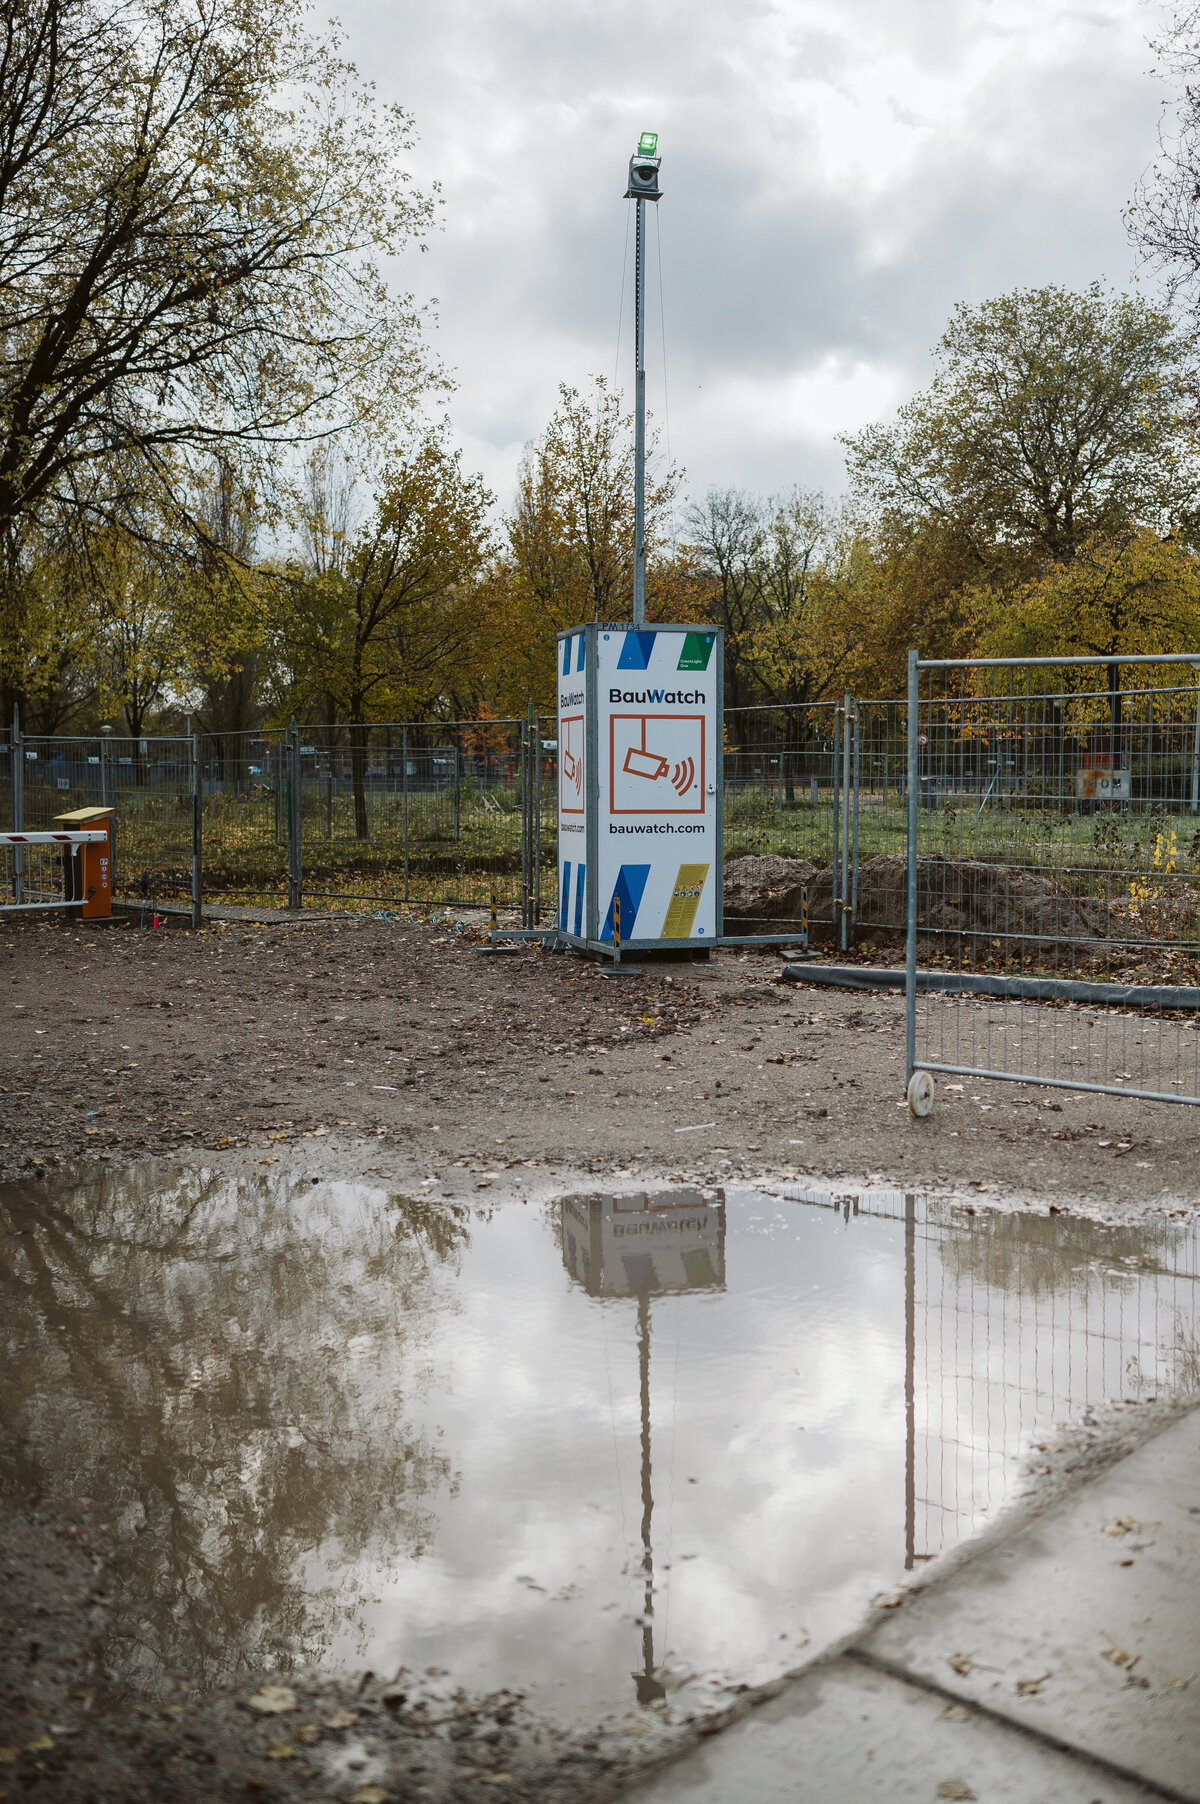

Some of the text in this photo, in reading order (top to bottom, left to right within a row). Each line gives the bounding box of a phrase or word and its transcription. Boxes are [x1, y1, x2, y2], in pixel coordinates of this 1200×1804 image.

[602, 622, 641, 631] PM 1734
[560, 691, 585, 708] BauWatch
[609, 688, 706, 704] BauWatch
[561, 822, 585, 833] bauwatch.com
[609, 823, 705, 834] bauwatch.com
